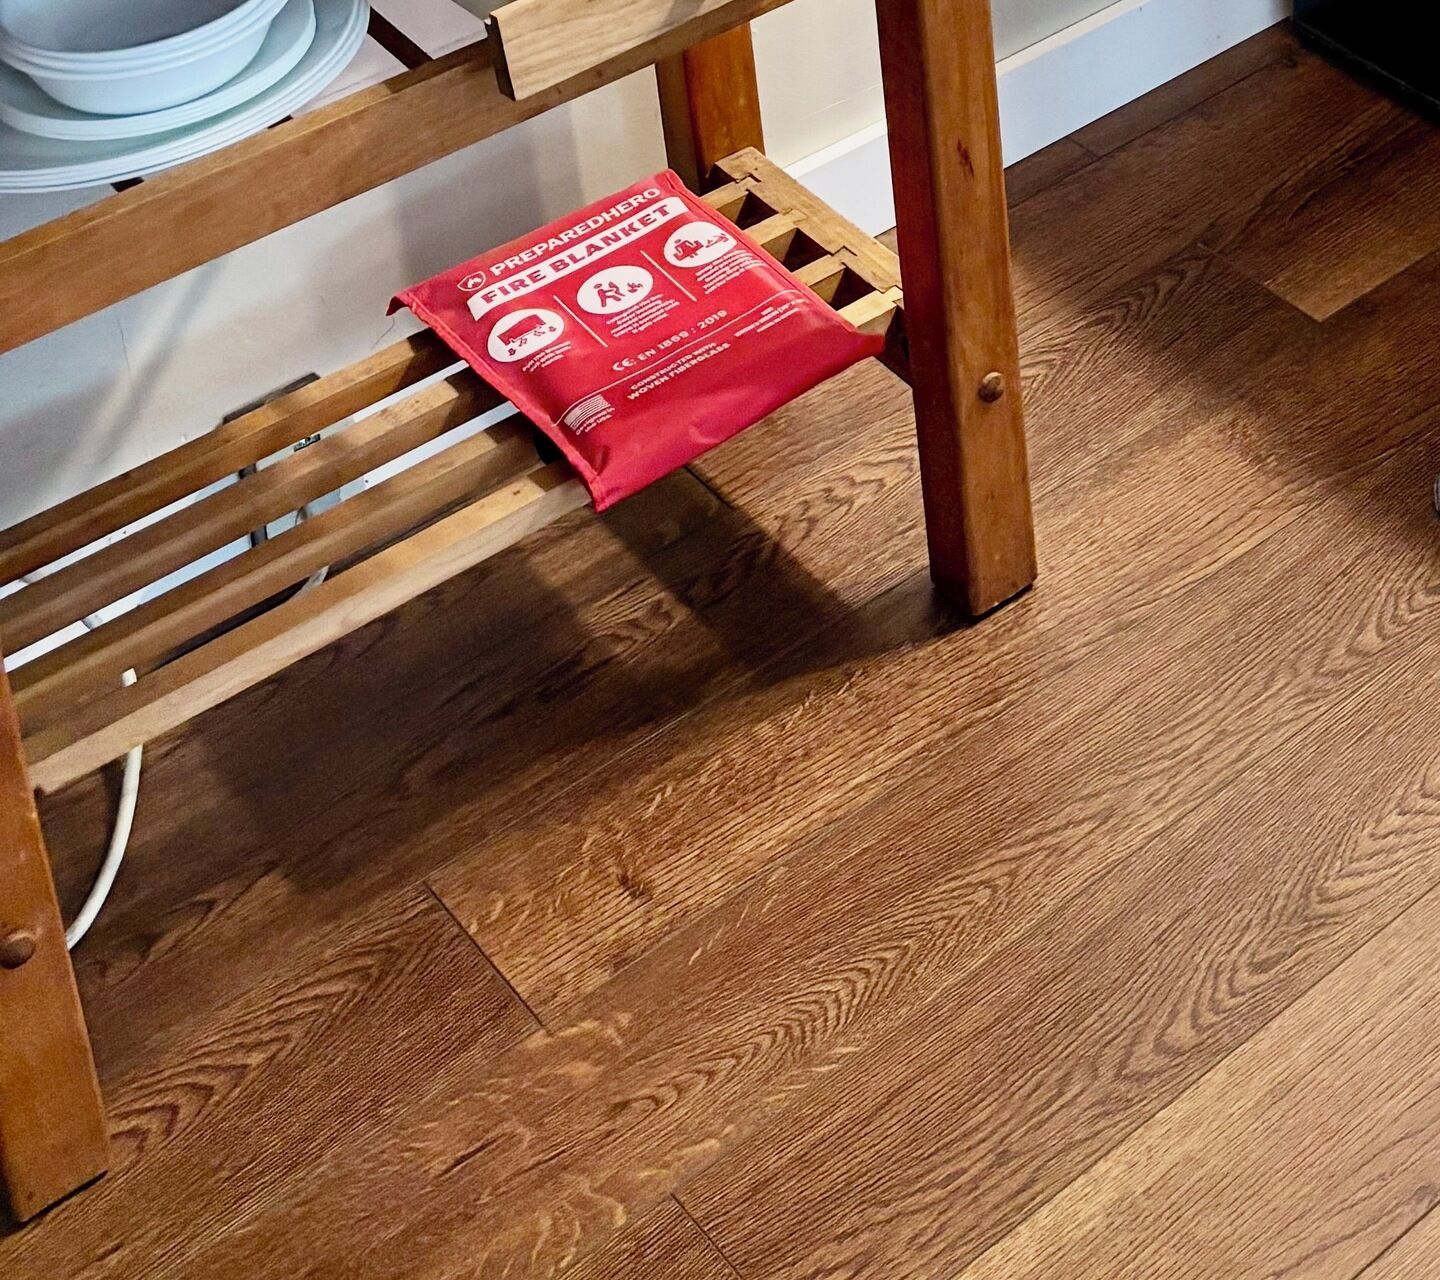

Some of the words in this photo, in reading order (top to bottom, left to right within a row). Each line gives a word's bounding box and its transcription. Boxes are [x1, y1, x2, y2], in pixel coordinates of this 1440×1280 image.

[481, 269, 547, 304] FIRE
[548, 204, 671, 273] BLANKET
[489, 188, 662, 277] PREPAREDHERO
[637, 348, 657, 361] EN
[657, 330, 690, 350] 1869
[697, 310, 728, 329] 2019
[627, 375, 670, 400] WOVEN
[669, 342, 731, 378] FIBERGLASS
[630, 354, 693, 390] CONSTRUCTED
[692, 342, 717, 356] WITH
